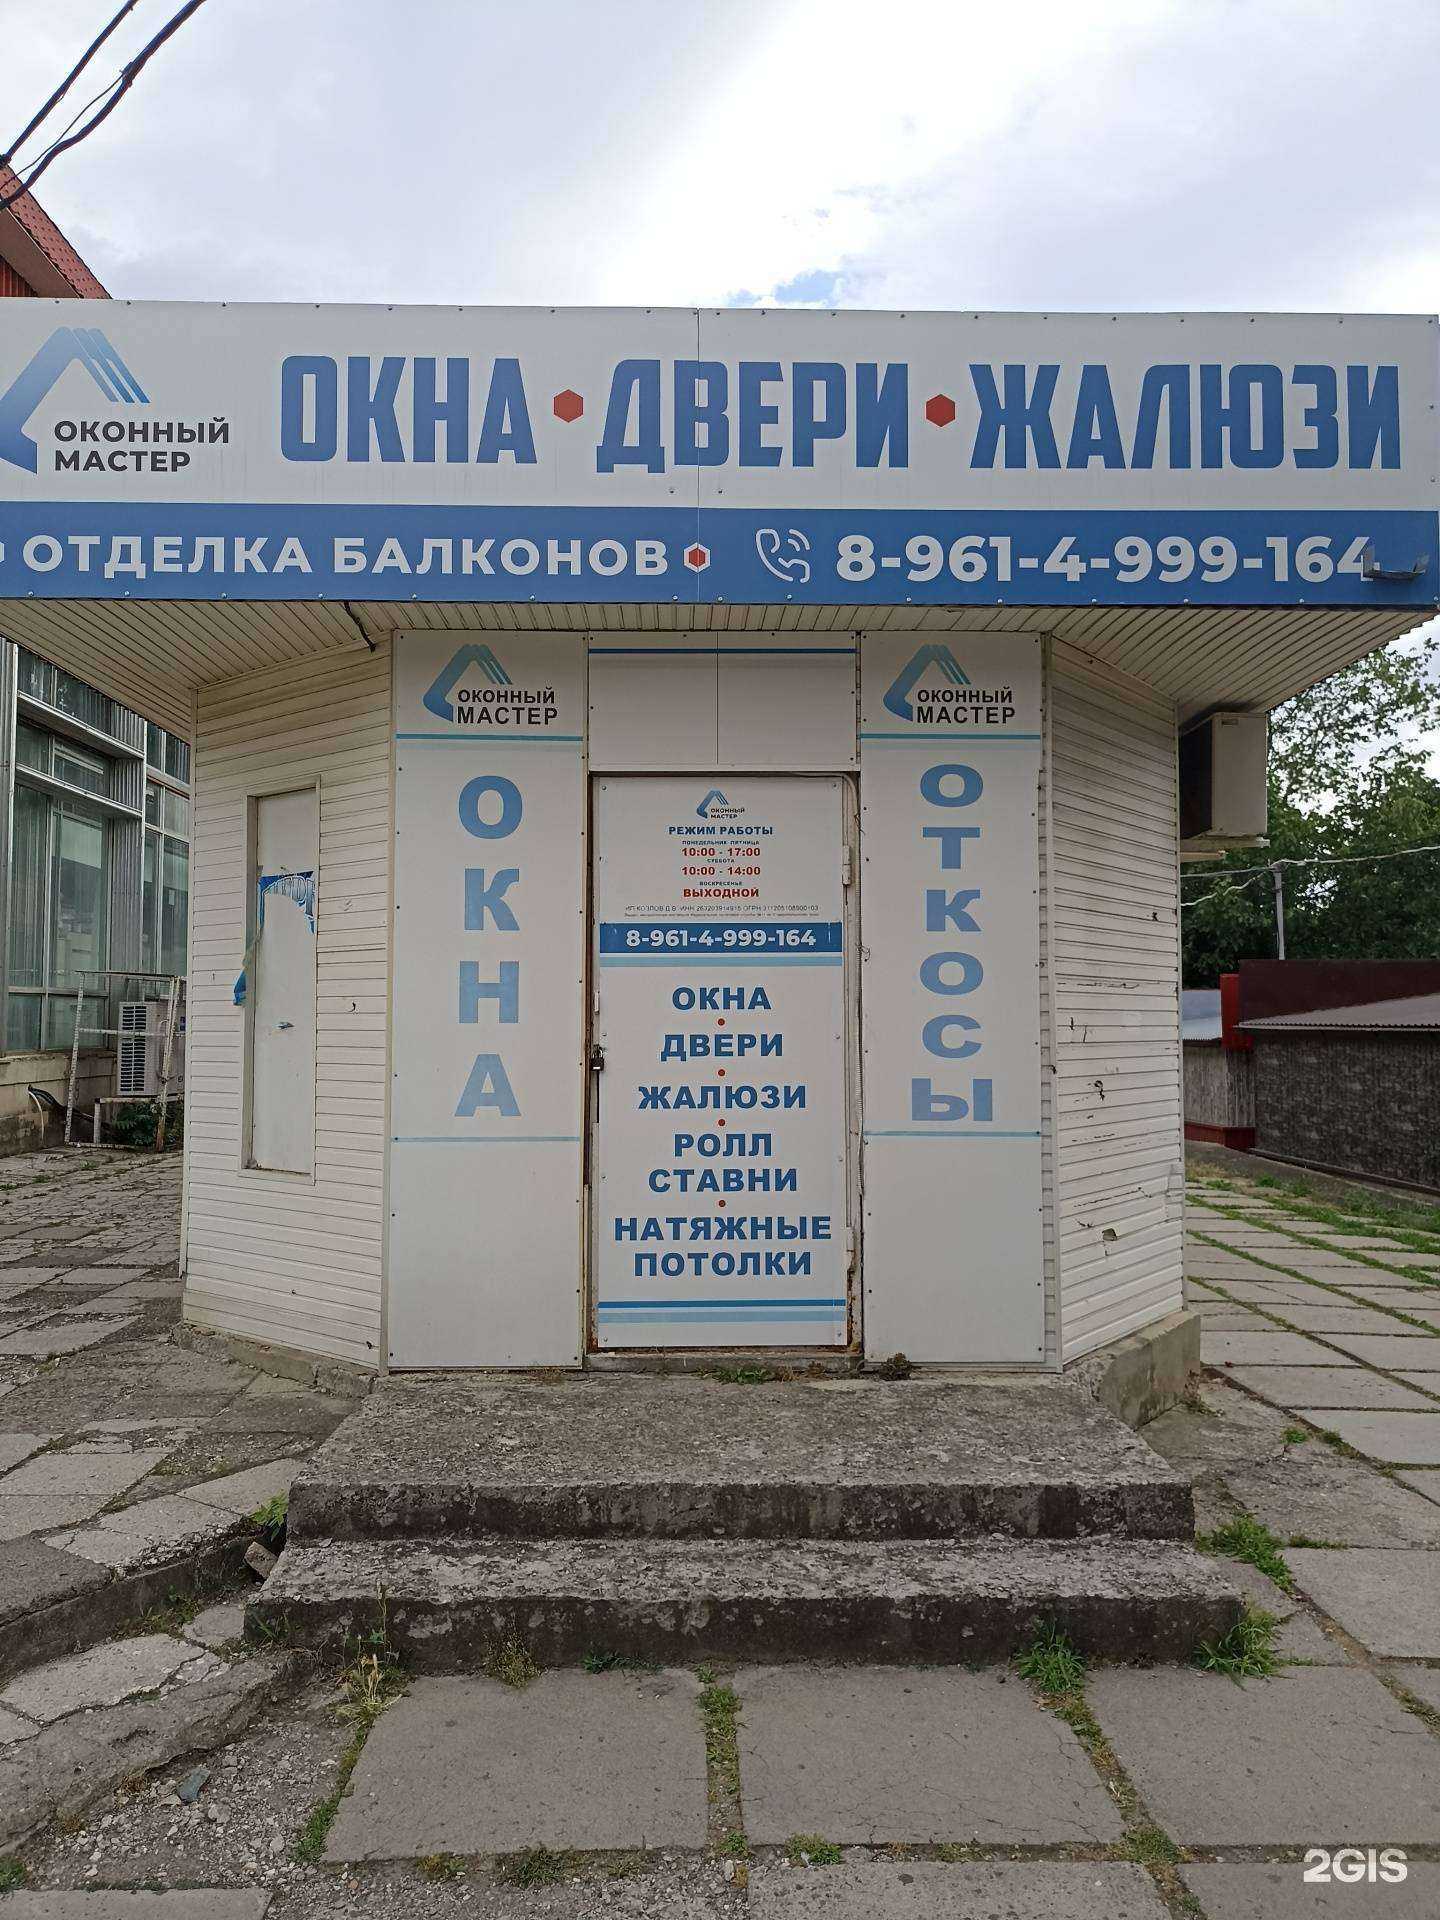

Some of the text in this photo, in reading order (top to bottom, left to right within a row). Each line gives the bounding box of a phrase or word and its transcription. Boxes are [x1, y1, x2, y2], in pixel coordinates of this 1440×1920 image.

[281, 356, 1400, 473] ОКНА ДВЕРИ ЖАЛЮЗИ
[54, 416, 230, 444] ОКОННЫЙ
[54, 450, 191, 472] МАСТЕР
[22, 534, 668, 579] ОТДЕЛКА БАЛКОНОВ
[836, 535, 1380, 582] 8-961-4-999-164
[458, 687, 555, 704] ОКОННЫЙ
[917, 686, 1013, 704] ОКОННЫЙ
[457, 706, 558, 725] МАСТЕР
[916, 706, 1015, 724] МАСТЕР
[668, 826, 773, 835] РЕЖИМ РАБОТЫ
[681, 847, 715, 857] 10:00
[727, 847, 761, 857] 17:00
[681, 866, 715, 876] 10:00
[727, 866, 761, 876] 14:00
[683, 887, 760, 899] ВЫХОДНОЙ
[454, 775, 523, 1116] ОКНА
[626, 930, 816, 947] 8-961-4-999-164
[911, 764, 993, 1121] ОТКОСЫ
[672, 987, 772, 1010] ОКНА
[660, 1034, 783, 1062] ДВЕРИ
[638, 1086, 806, 1109] ЖАЛЮЗИ
[674, 1134, 772, 1157] РОЛЛ
[648, 1169, 797, 1192] СТАВНИ
[614, 1216, 831, 1241] НАТЯЖНЫЕ
[634, 1252, 811, 1277] ПОТОЛКИ
